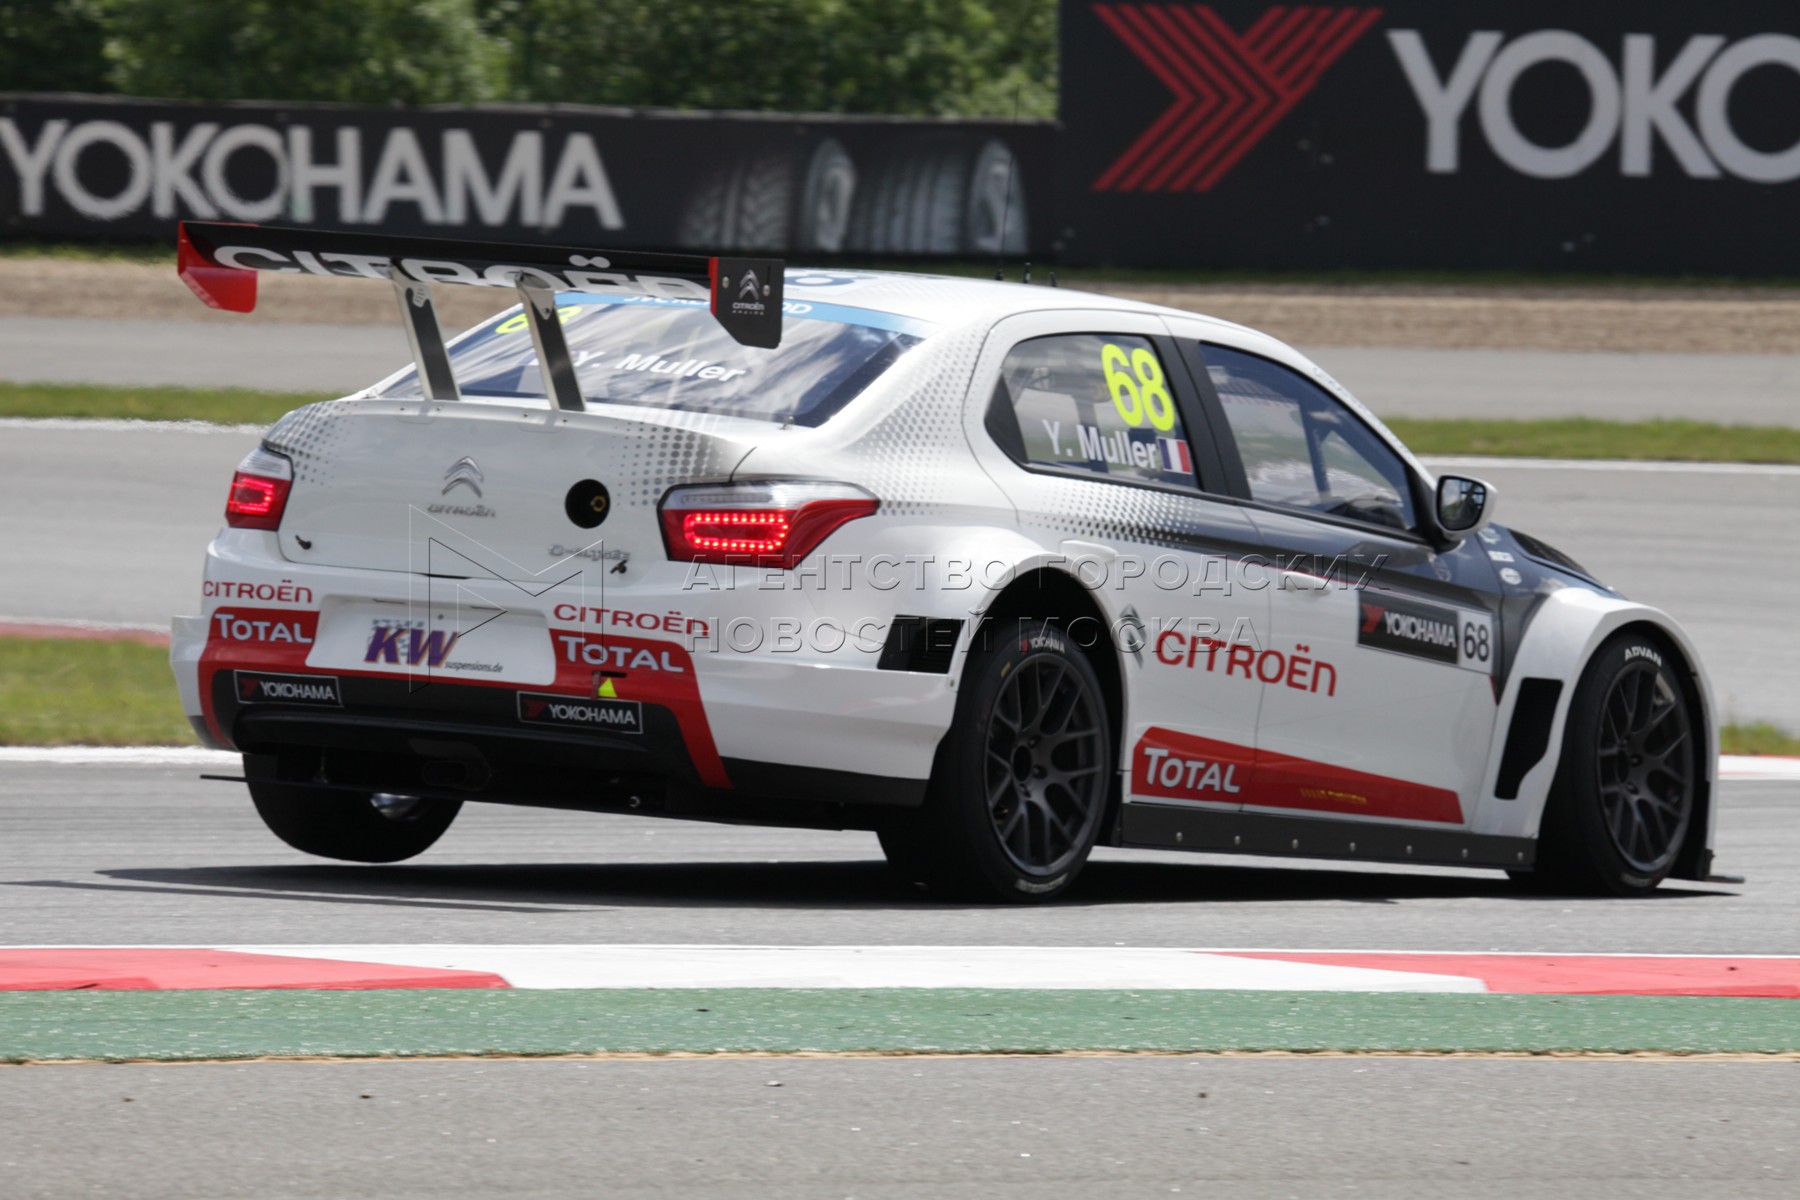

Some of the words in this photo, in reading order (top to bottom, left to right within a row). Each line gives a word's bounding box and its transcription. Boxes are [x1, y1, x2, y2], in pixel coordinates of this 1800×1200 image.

[1384, 27, 1800, 183] YOKO
[0, 117, 624, 230] YOKOHAMA
[615, 353, 747, 382] Muller
[1101, 343, 1175, 431] 68
[1041, 418, 1074, 457] Y.
[1076, 424, 1157, 469] Muller
[363, 626, 461, 668] KW
[1384, 610, 1458, 649] YOKOHAMA
[1463, 621, 1490, 662] 68
[1624, 645, 1663, 667] ADVAN
[260, 681, 337, 701] YOKOHAMA
[549, 703, 637, 725] YOKOHAMA
